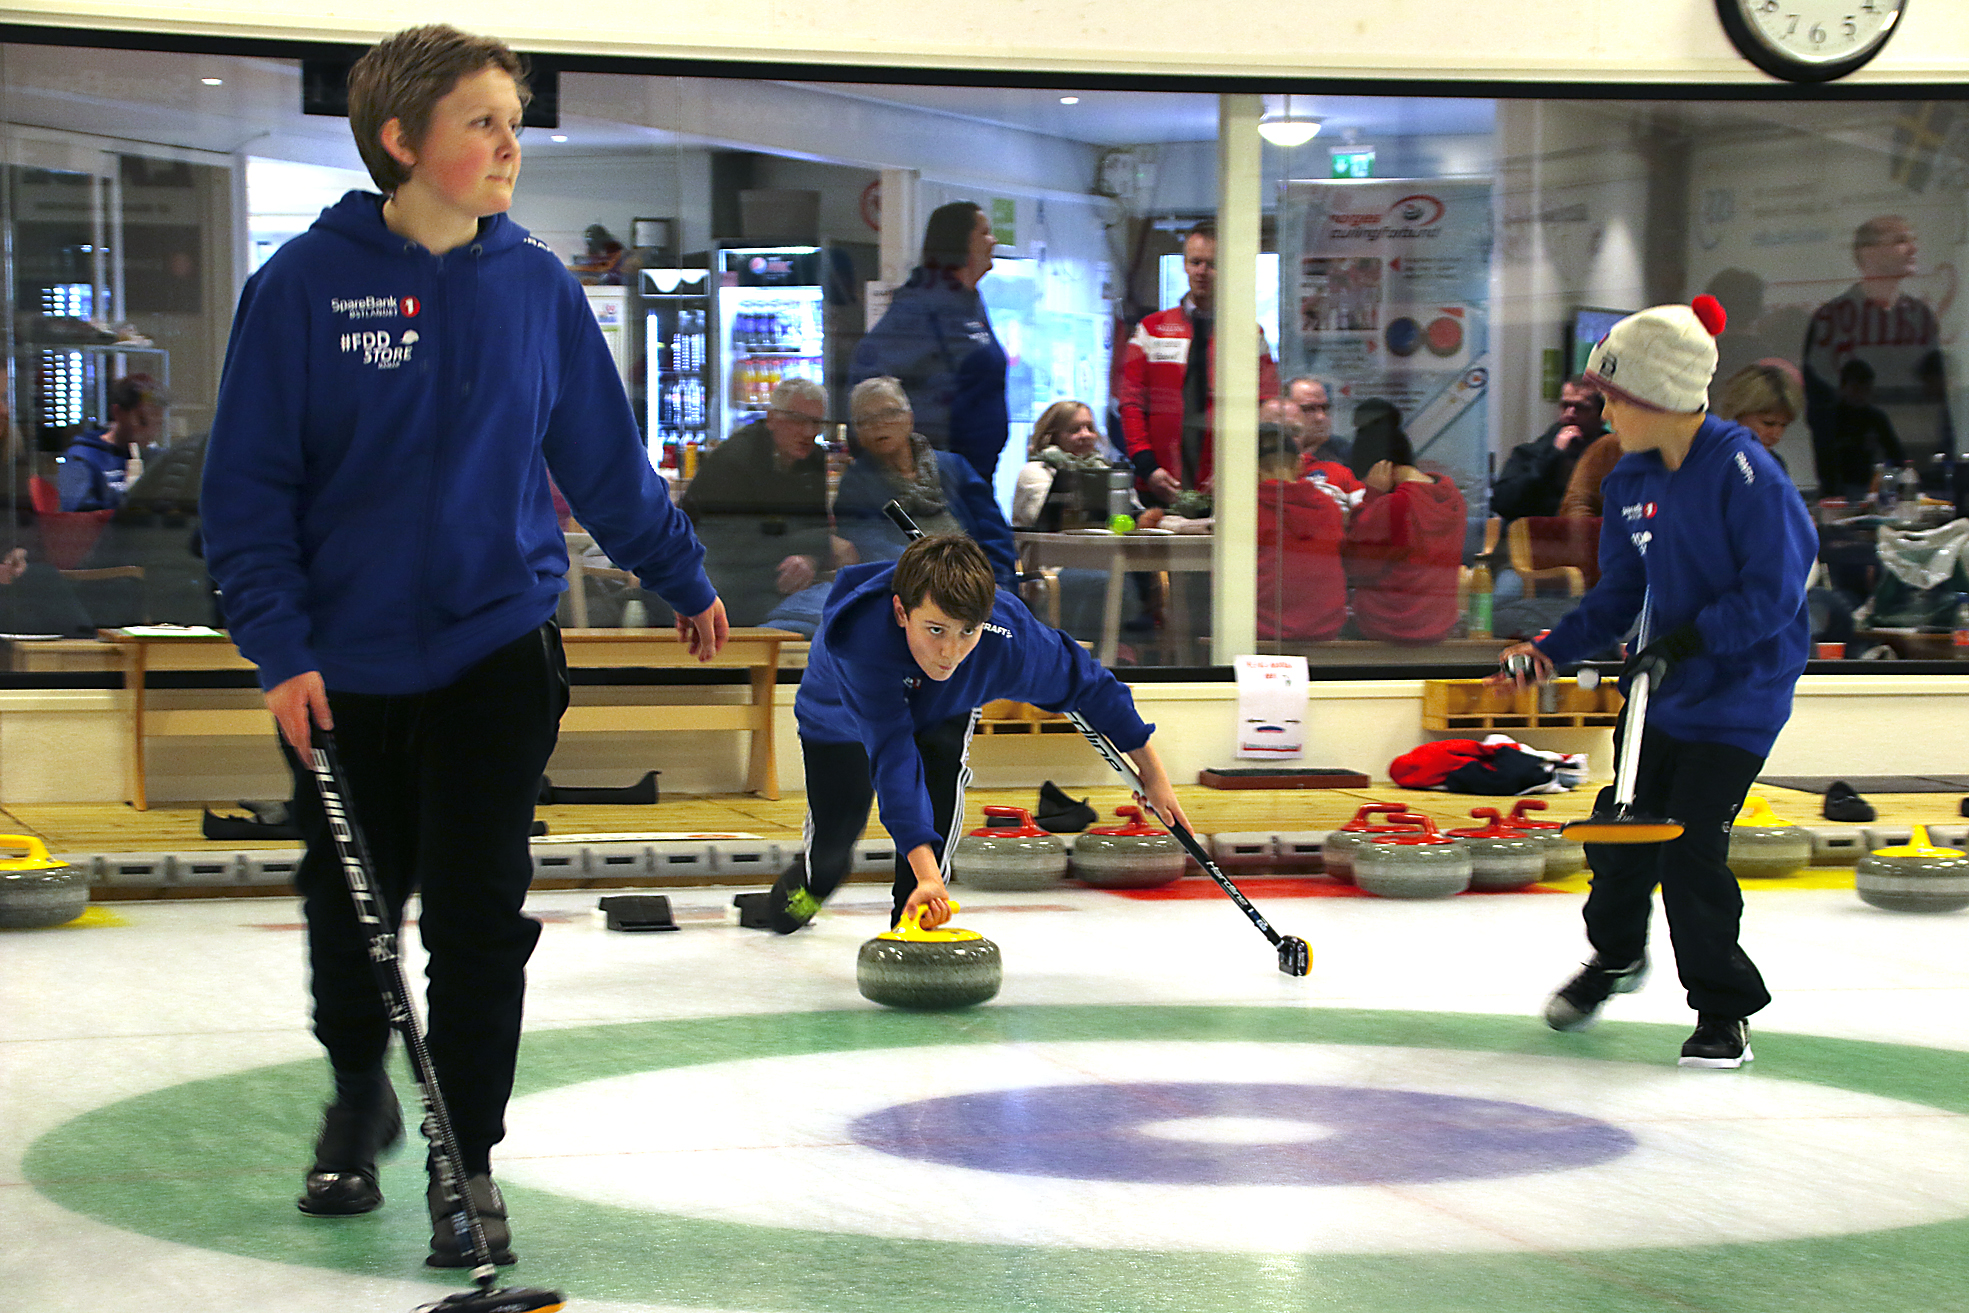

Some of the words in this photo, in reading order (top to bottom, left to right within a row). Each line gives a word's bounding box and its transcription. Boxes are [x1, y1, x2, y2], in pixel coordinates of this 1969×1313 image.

[1785, 14, 1800, 35] 7
[1808, 21, 1827, 44] 6
[1842, 14, 1857, 37] 5
[331, 295, 398, 313] SpareBank
[405, 298, 414, 315] 1
[363, 345, 413, 365] STORE
[1206, 861, 1248, 906] Hardline
